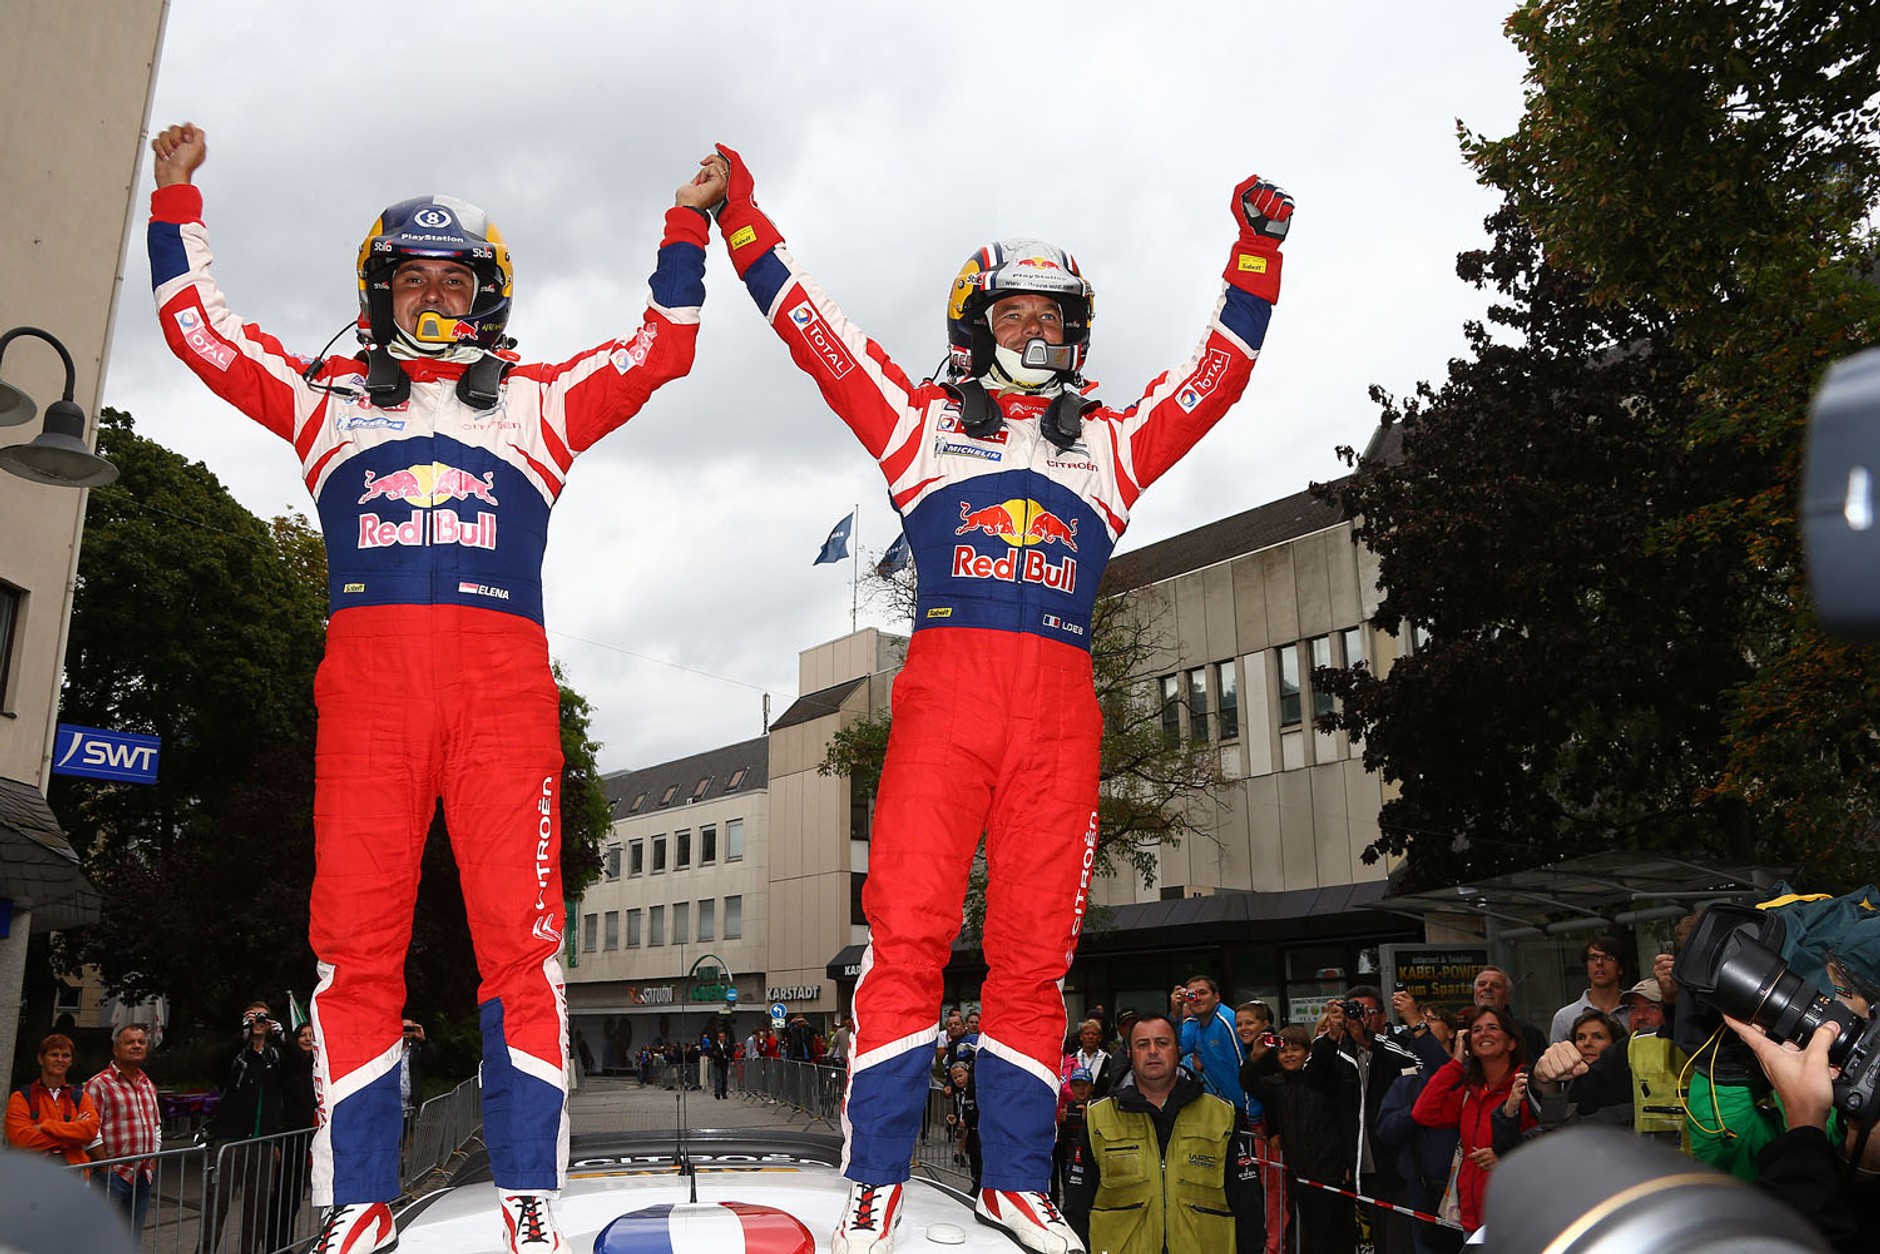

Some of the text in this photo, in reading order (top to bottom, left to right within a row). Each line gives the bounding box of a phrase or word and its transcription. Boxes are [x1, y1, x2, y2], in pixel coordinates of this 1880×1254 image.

[427, 211, 439, 224] 8
[374, 239, 393, 252] Stilo
[401, 233, 464, 243] PlayStation
[472, 246, 493, 259] Stilo
[192, 333, 227, 366] OTAL
[810, 324, 844, 373] TOTAL
[1194, 353, 1225, 390] TOTAL
[947, 444, 1000, 460] MICHELIN
[358, 509, 497, 550] Red Bull
[952, 545, 1077, 594] Red Bull
[478, 585, 509, 600] ELENA
[928, 608, 950, 617] Sabelt
[1062, 621, 1084, 635] LOEB
[83, 740, 158, 771] SWT
[844, 965, 862, 976] KAR
[766, 985, 819, 1001] KARSTADT
[1407, 982, 1474, 998] um Sparta
[1189, 1153, 1217, 1164] WRC
